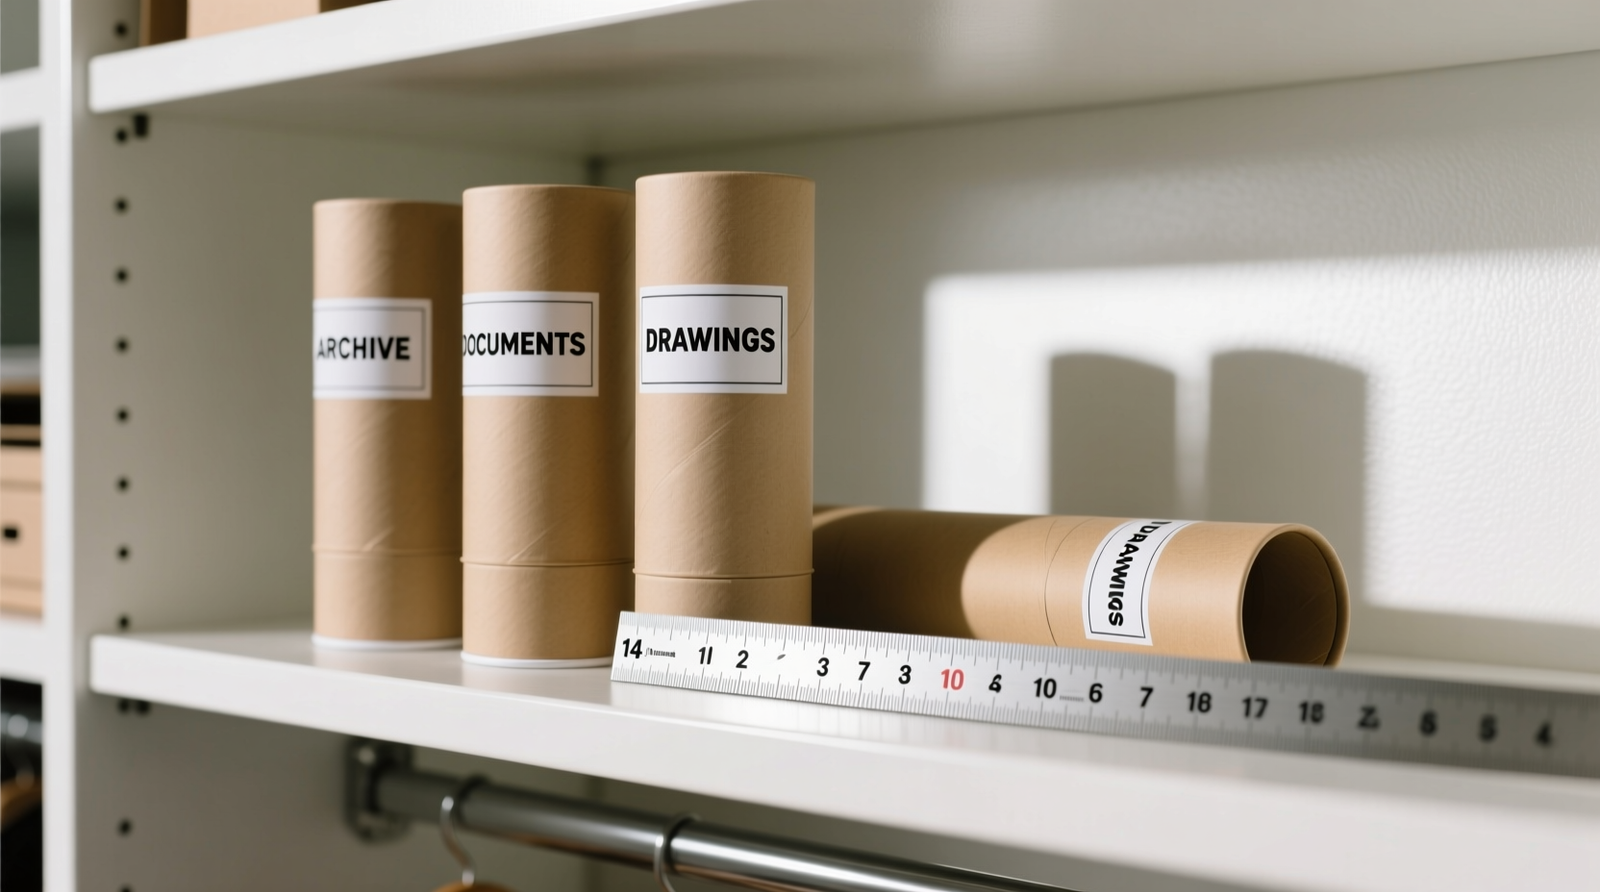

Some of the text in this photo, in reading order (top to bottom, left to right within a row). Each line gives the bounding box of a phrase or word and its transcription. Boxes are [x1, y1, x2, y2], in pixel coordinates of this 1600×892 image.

[317, 336, 411, 361] ARCHIVE
[646, 326, 776, 354] DRAWINGS
[622, 638, 643, 660] 14
[735, 649, 749, 669] 2
[816, 657, 830, 677] 3
[858, 661, 871, 681] 7
[898, 664, 912, 685] 3
[941, 668, 965, 691] 10
[1033, 677, 1058, 699] 10
[1088, 682, 1103, 704] 6
[1140, 686, 1154, 708] 7
[1242, 696, 1269, 719] 17
